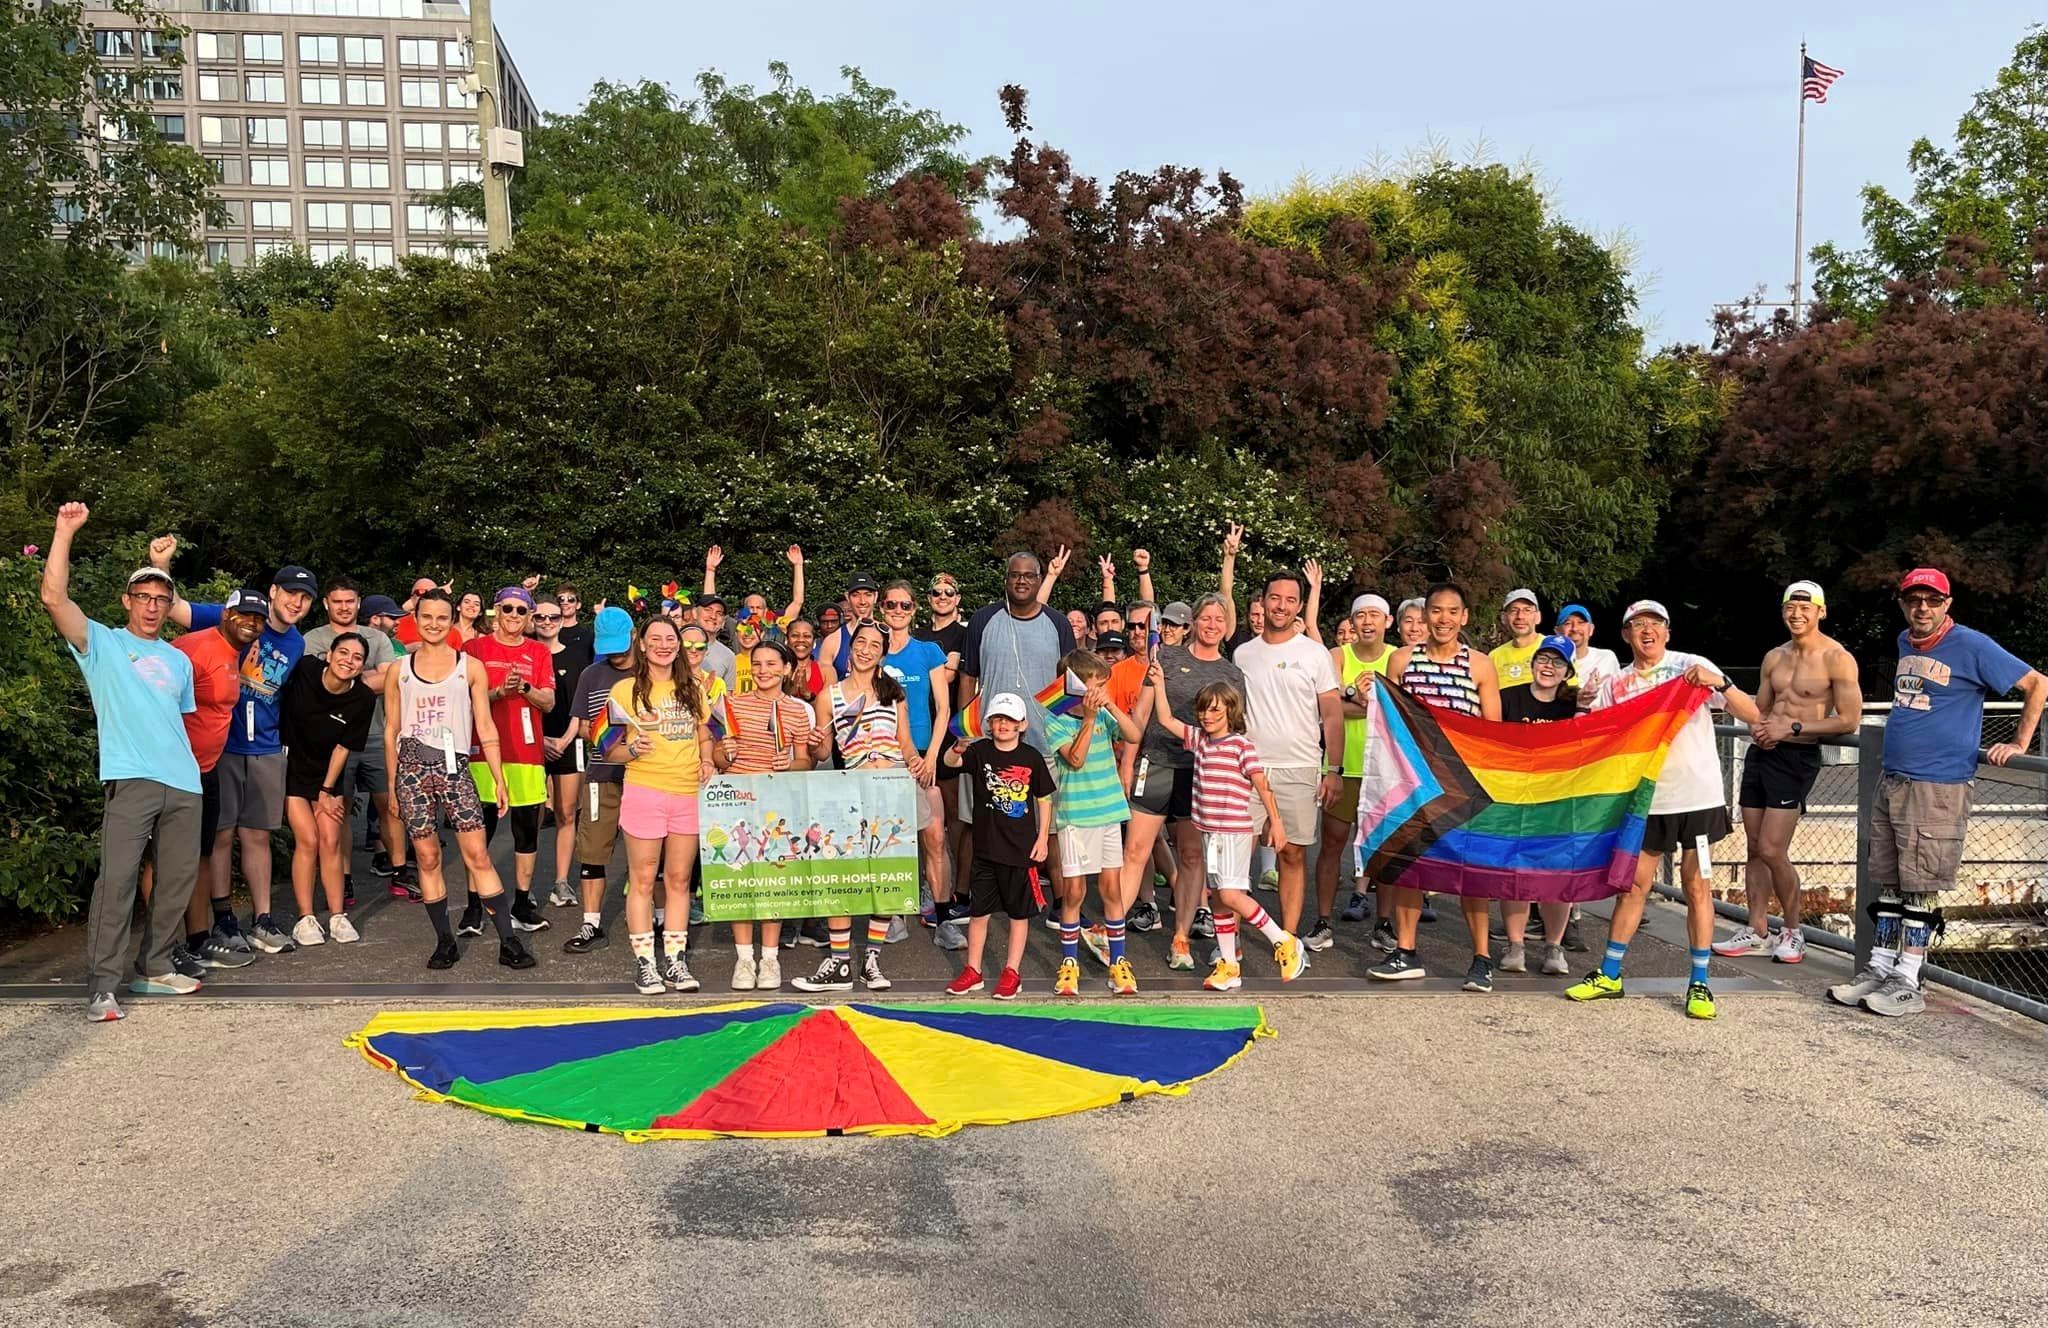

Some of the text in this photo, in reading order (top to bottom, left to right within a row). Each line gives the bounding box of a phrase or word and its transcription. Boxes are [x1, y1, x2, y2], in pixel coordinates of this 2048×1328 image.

[262, 656, 288, 686] 5K
[1414, 685, 1439, 696] PRIDE
[416, 695, 446, 709] LIVE
[416, 710, 445, 726] LIFE
[659, 722, 694, 736] World
[710, 871, 913, 889] GET MOVING IN YOUR HOME PARK
[711, 892, 731, 900] Free
[754, 890, 771, 898] and
[773, 889, 799, 898] walks
[801, 889, 824, 897] every
[826, 886, 863, 896] Tuesday
[865, 886, 873, 894] at
[875, 885, 881, 894] 7
[711, 902, 747, 911] Everyone
[757, 899, 791, 909] welcome
[793, 899, 801, 907] at
[803, 898, 823, 907] Open
[824, 897, 841, 906] Run
